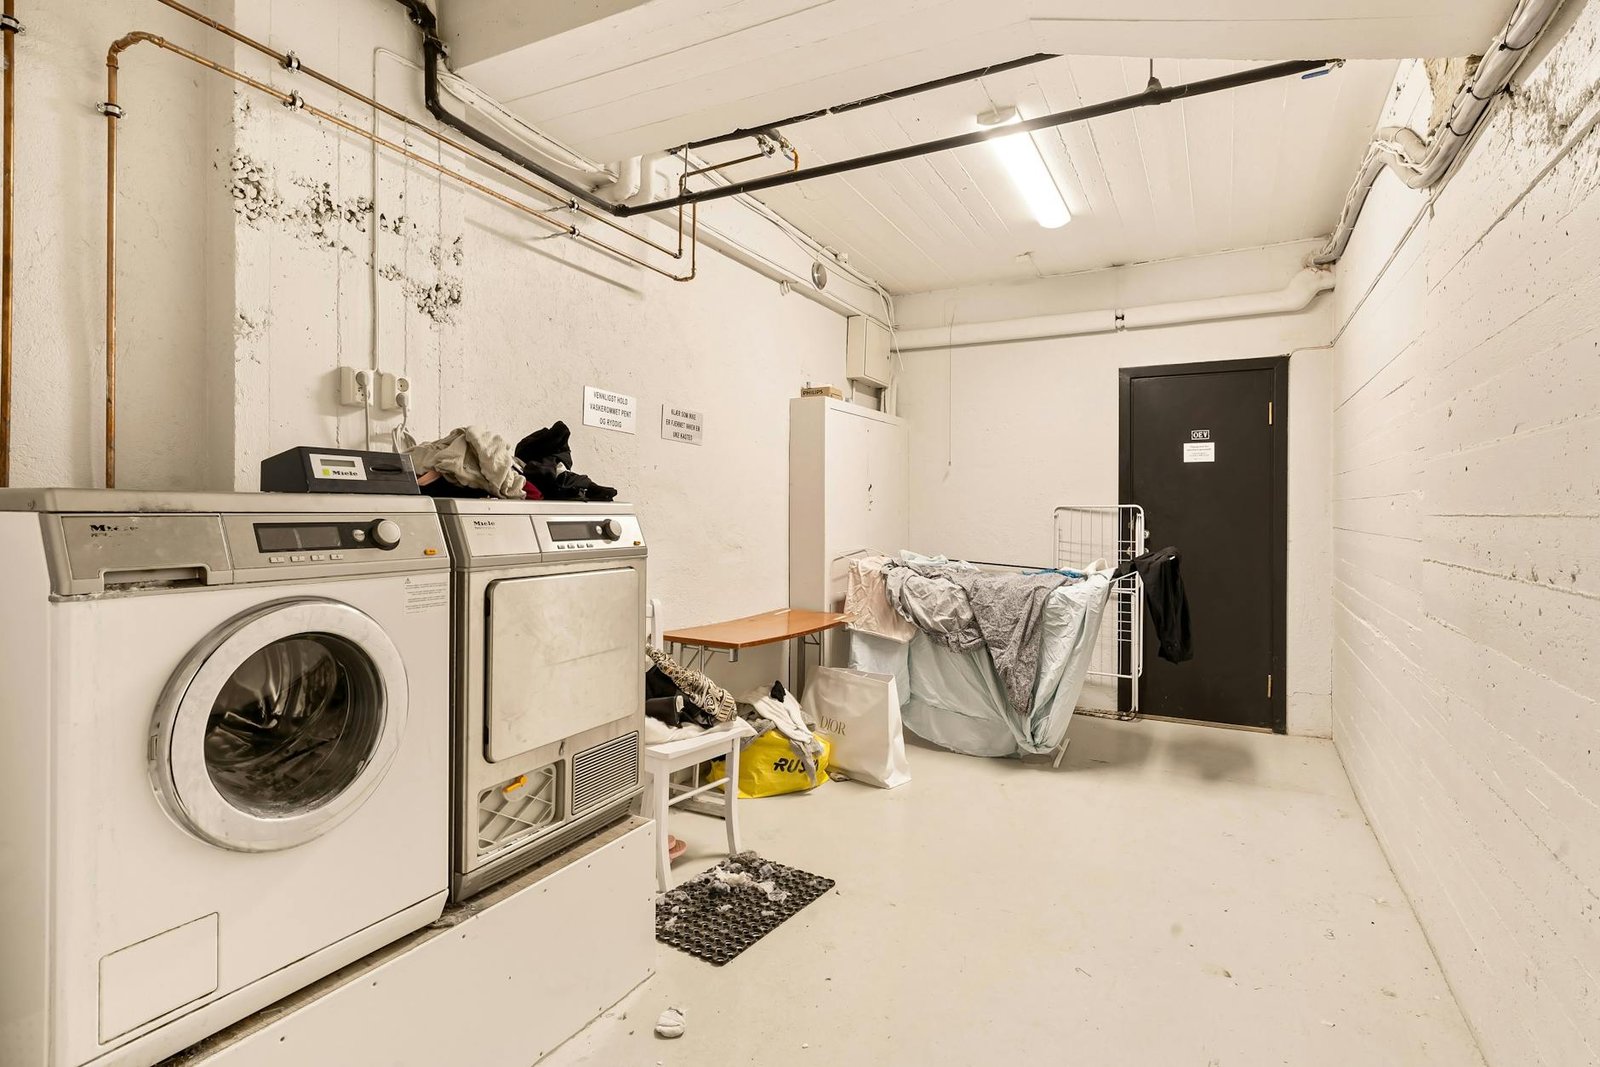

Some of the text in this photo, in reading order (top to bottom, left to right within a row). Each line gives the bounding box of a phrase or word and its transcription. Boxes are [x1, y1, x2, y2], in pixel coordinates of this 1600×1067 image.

[593, 391, 628, 406] VENNLIGST HOLD
[590, 403, 632, 418] VASKEROMMET PENT
[600, 417, 622, 428] OG RYDDIG
[821, 716, 846, 736] DIOR
